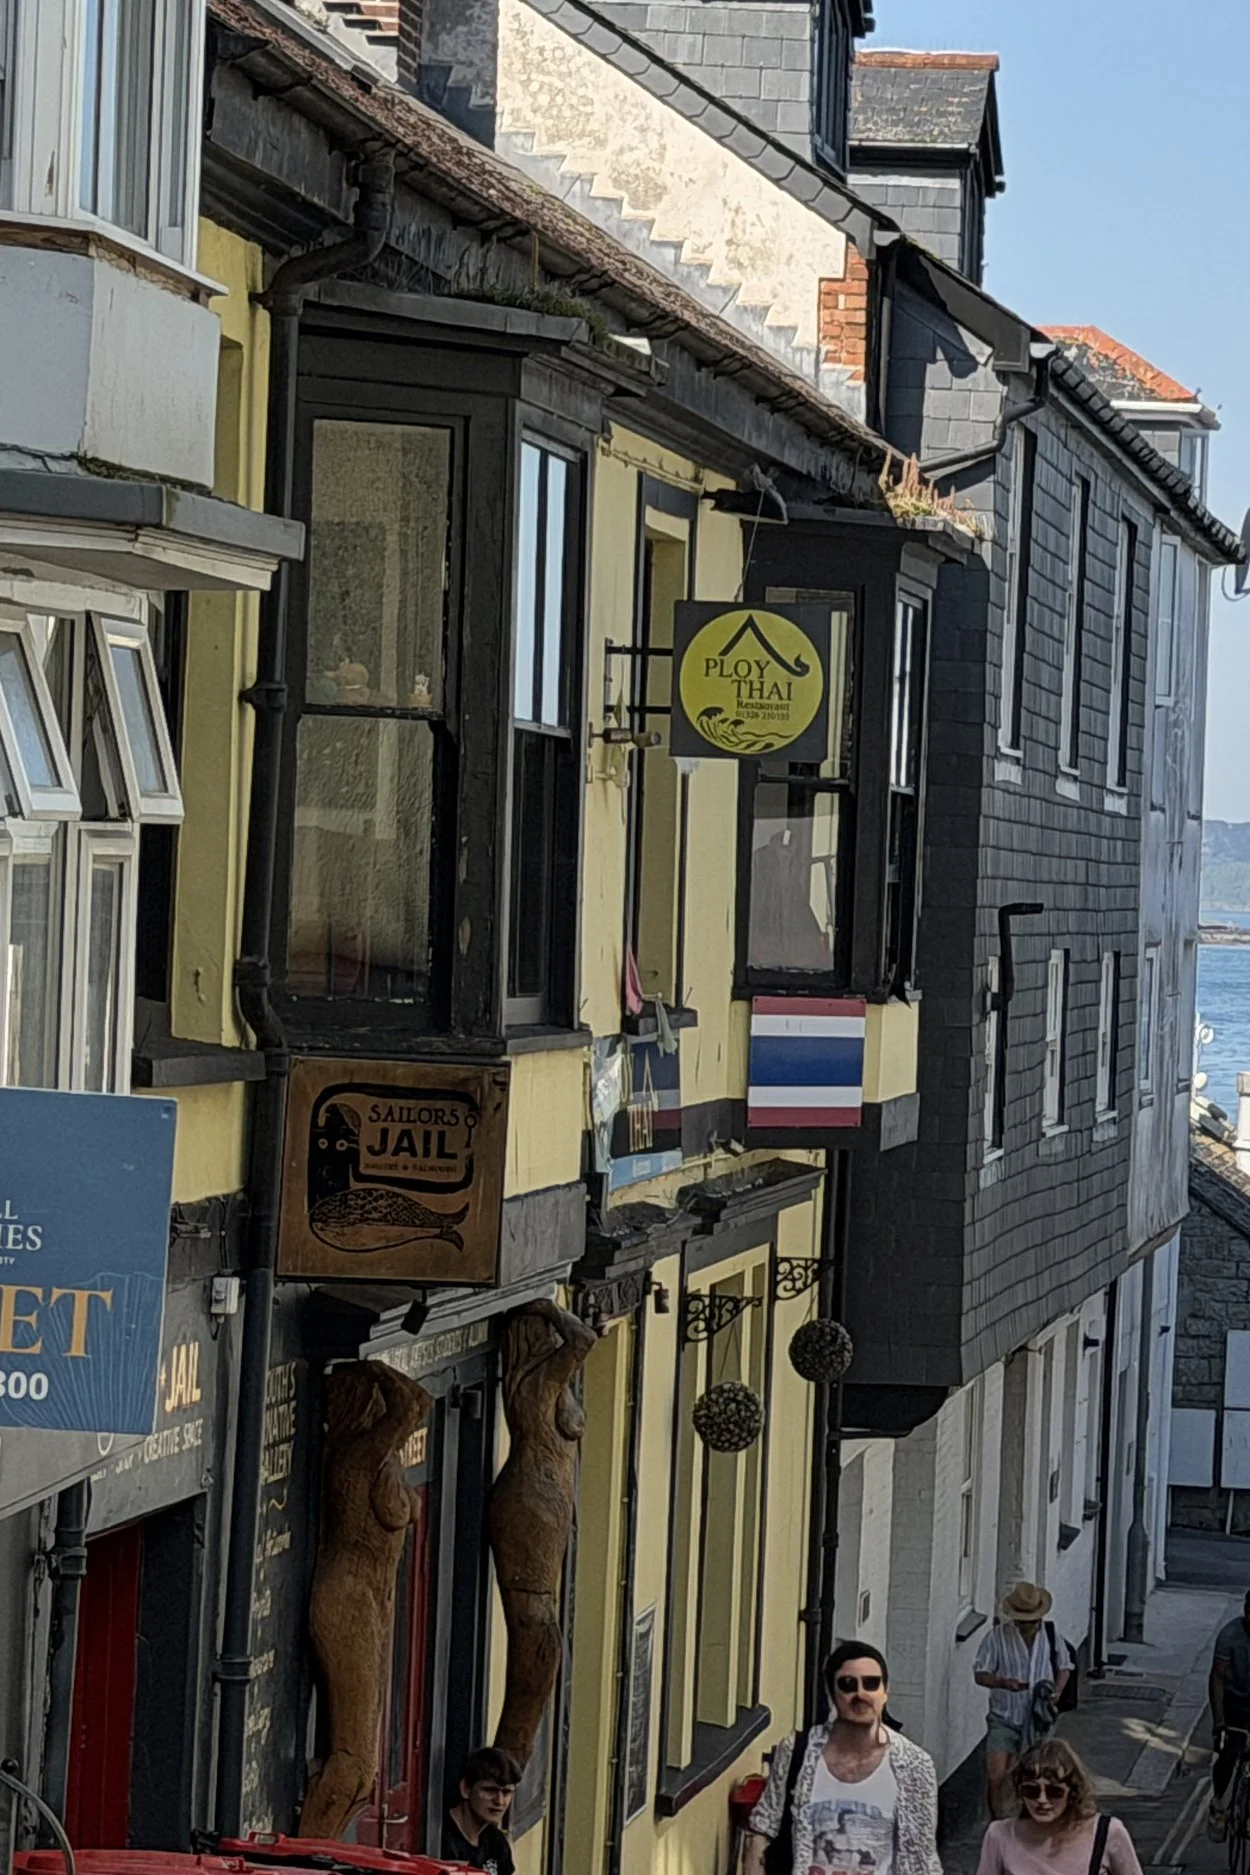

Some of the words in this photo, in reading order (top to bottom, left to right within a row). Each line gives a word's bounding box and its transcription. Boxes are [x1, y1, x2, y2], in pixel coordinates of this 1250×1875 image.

[703, 658, 771, 678] PLOY
[731, 679, 793, 701] THAI
[368, 1103, 460, 1127] SAILORS
[627, 1100, 654, 1153] THAI
[366, 1127, 459, 1160] JAIL
[165, 1341, 201, 1412] JAIL
